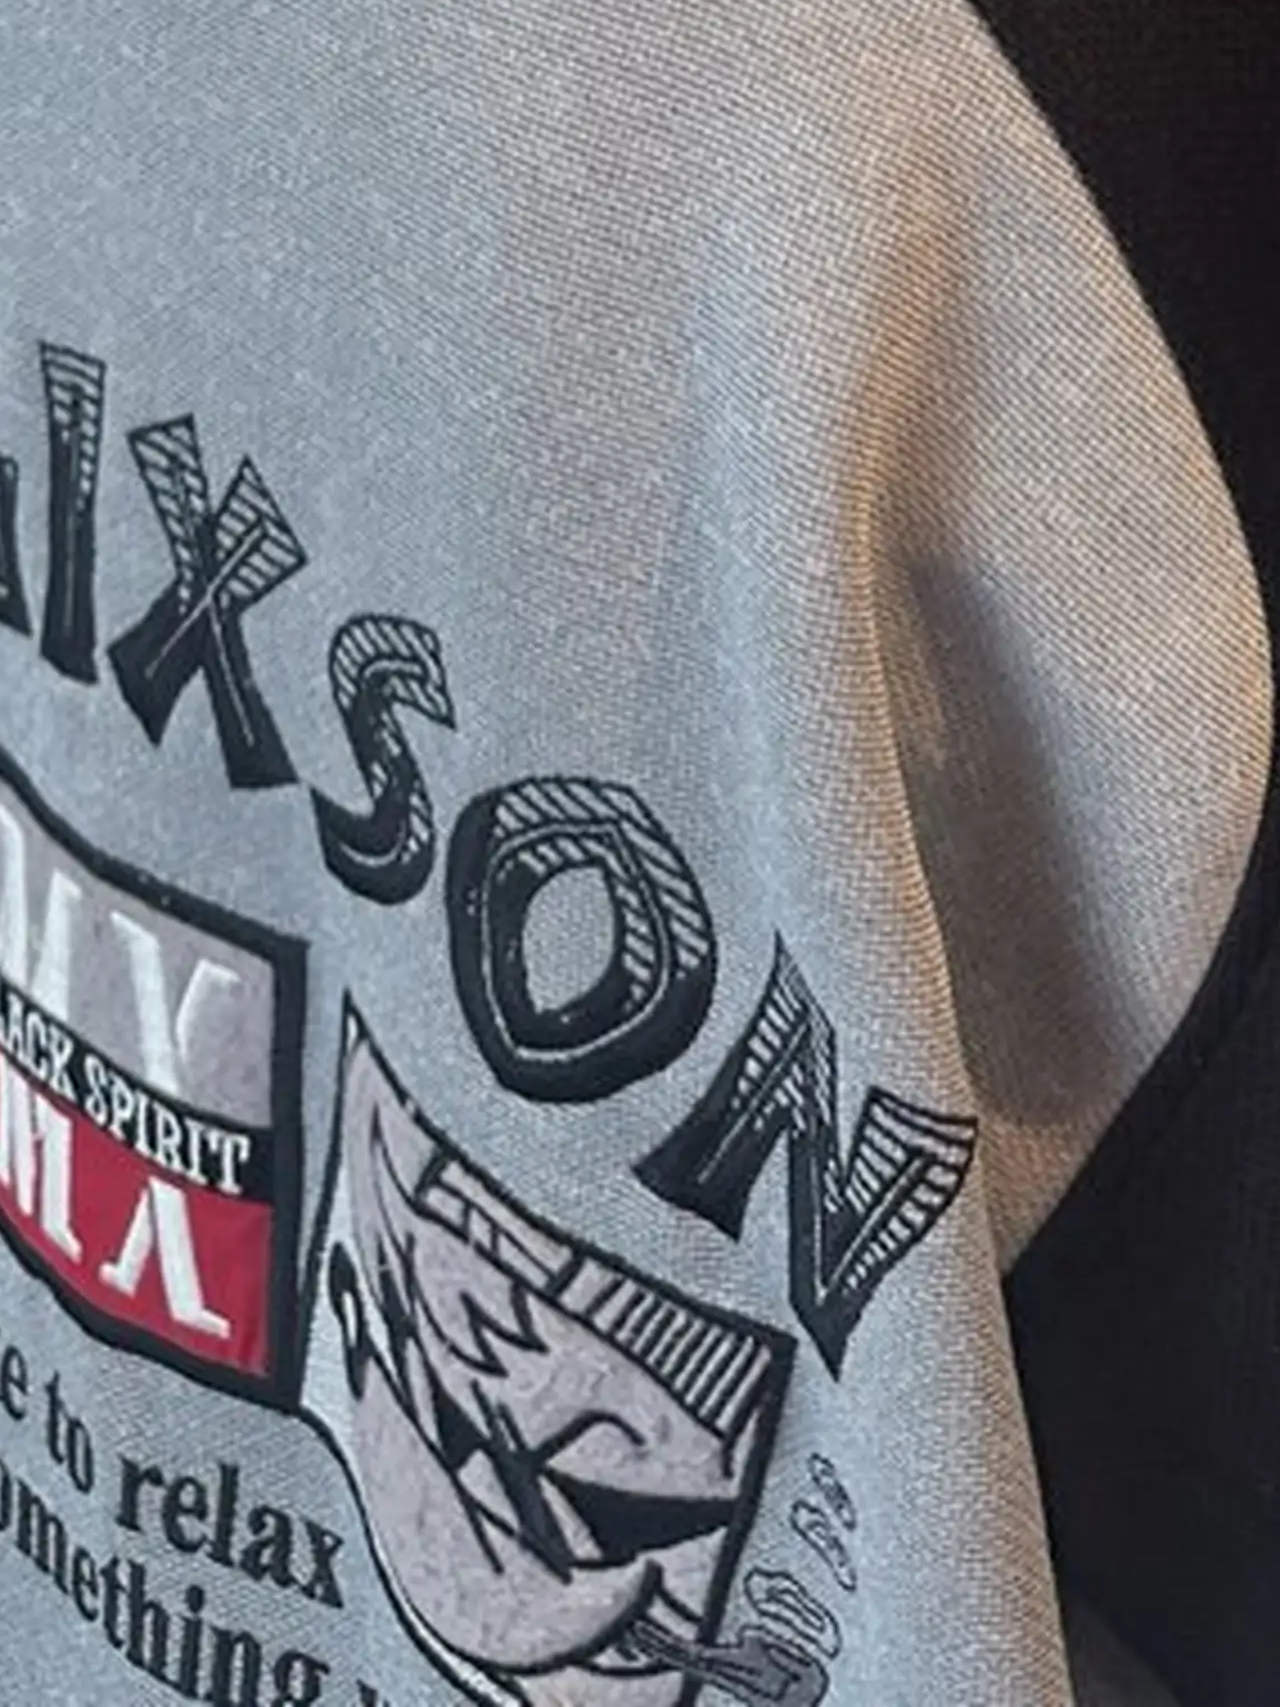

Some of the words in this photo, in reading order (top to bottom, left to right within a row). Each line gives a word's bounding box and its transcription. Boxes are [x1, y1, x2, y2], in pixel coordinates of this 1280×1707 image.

[83, 1051, 251, 1199] SPIRIT
[44, 1369, 96, 1495] to
[115, 1451, 346, 1611] relax
